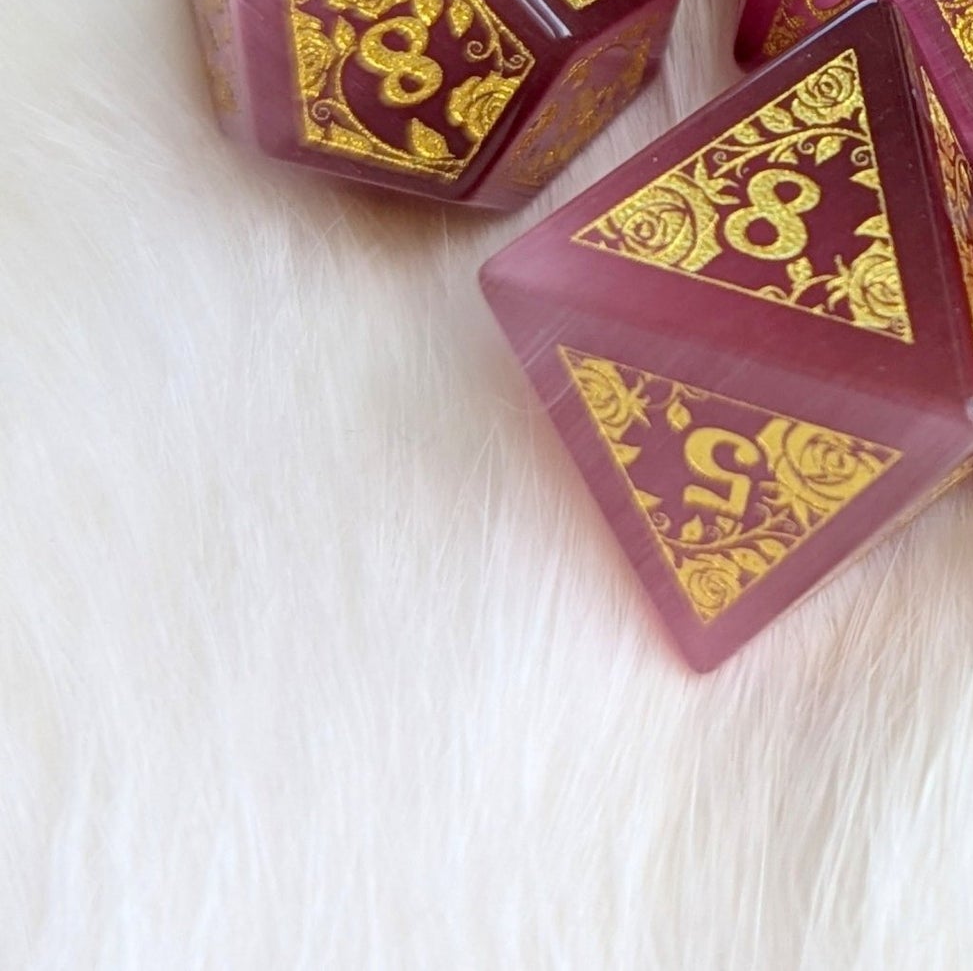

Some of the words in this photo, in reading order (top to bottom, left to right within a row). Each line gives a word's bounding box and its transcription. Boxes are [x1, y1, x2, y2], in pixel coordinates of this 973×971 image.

[358, 15, 444, 107] 8
[723, 169, 822, 261] 8
[682, 425, 762, 519] 5
